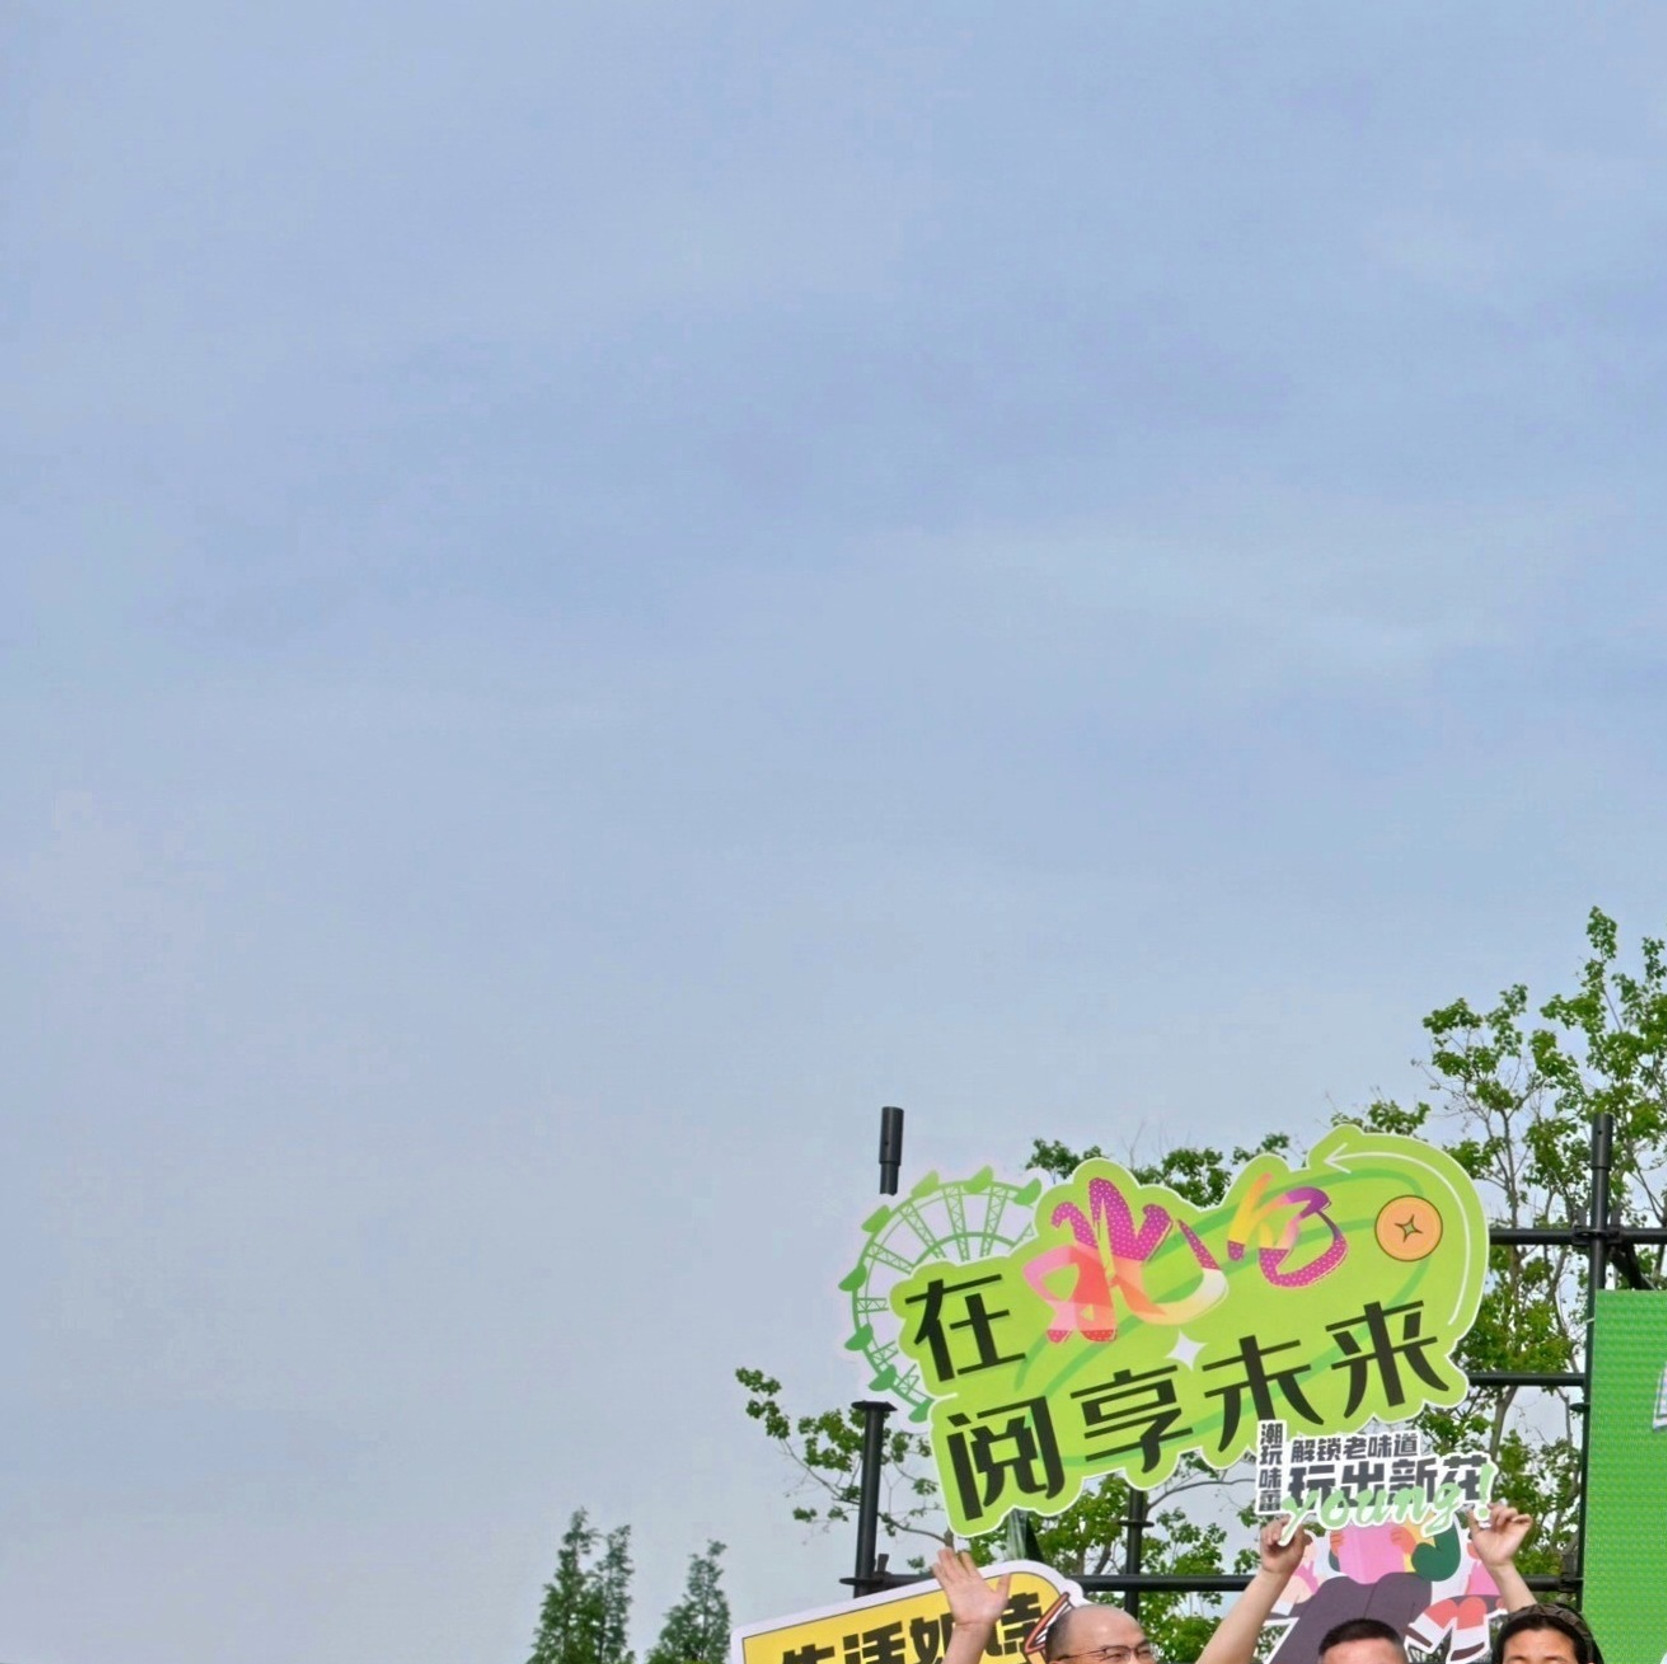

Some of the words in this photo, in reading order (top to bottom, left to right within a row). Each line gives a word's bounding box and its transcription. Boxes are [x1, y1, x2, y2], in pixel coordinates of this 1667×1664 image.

[947, 1301, 1450, 1521] 阅享未来
[1290, 1433, 1418, 1462] 解锁老味道
[1287, 1454, 1488, 1510] 玩出新花
